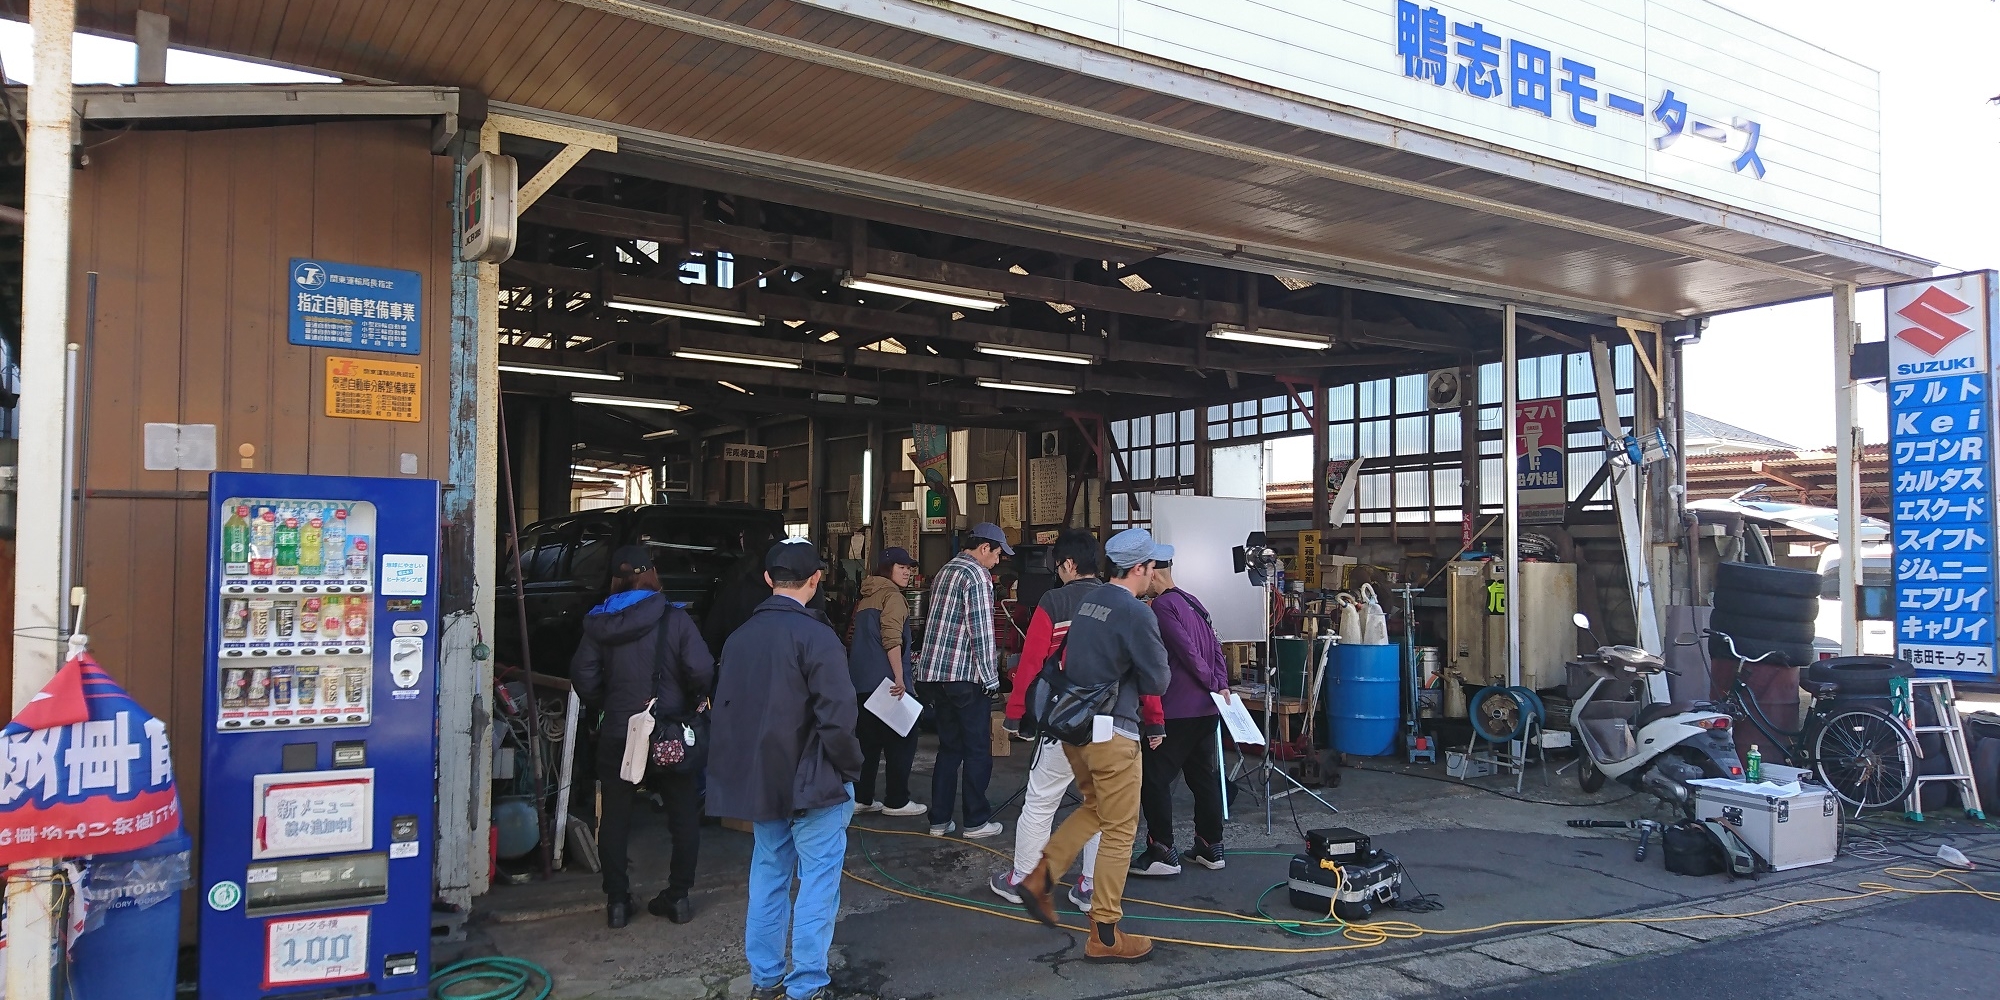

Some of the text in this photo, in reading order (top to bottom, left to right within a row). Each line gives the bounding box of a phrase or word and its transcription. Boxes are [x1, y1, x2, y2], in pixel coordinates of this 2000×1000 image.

[1395, 0, 1767, 181] 鴨志田モータース
[465, 187, 481, 210] JCB
[297, 292, 416, 323] 指定自動車整備事業
[1897, 356, 1975, 376] SUZUKI
[1893, 377, 1983, 407] アルト
[1895, 408, 1981, 436] Kei
[1895, 436, 1983, 465] ワゴンR
[1896, 467, 1985, 493] カルタス
[1897, 497, 1985, 522] エスクード
[1898, 527, 1986, 551] スイフト
[1898, 557, 1988, 582] ジムニー
[1899, 586, 1988, 612] エブリイ
[259, 611, 268, 636] BOSS
[1901, 615, 1988, 641] キャリイ
[1902, 647, 1988, 668] 鴨志田モータース
[329, 678, 338, 702] BOSS
[276, 798, 355, 820] 新メニュー
[275, 918, 339, 933] ドリンク各種
[281, 933, 352, 968] 100
